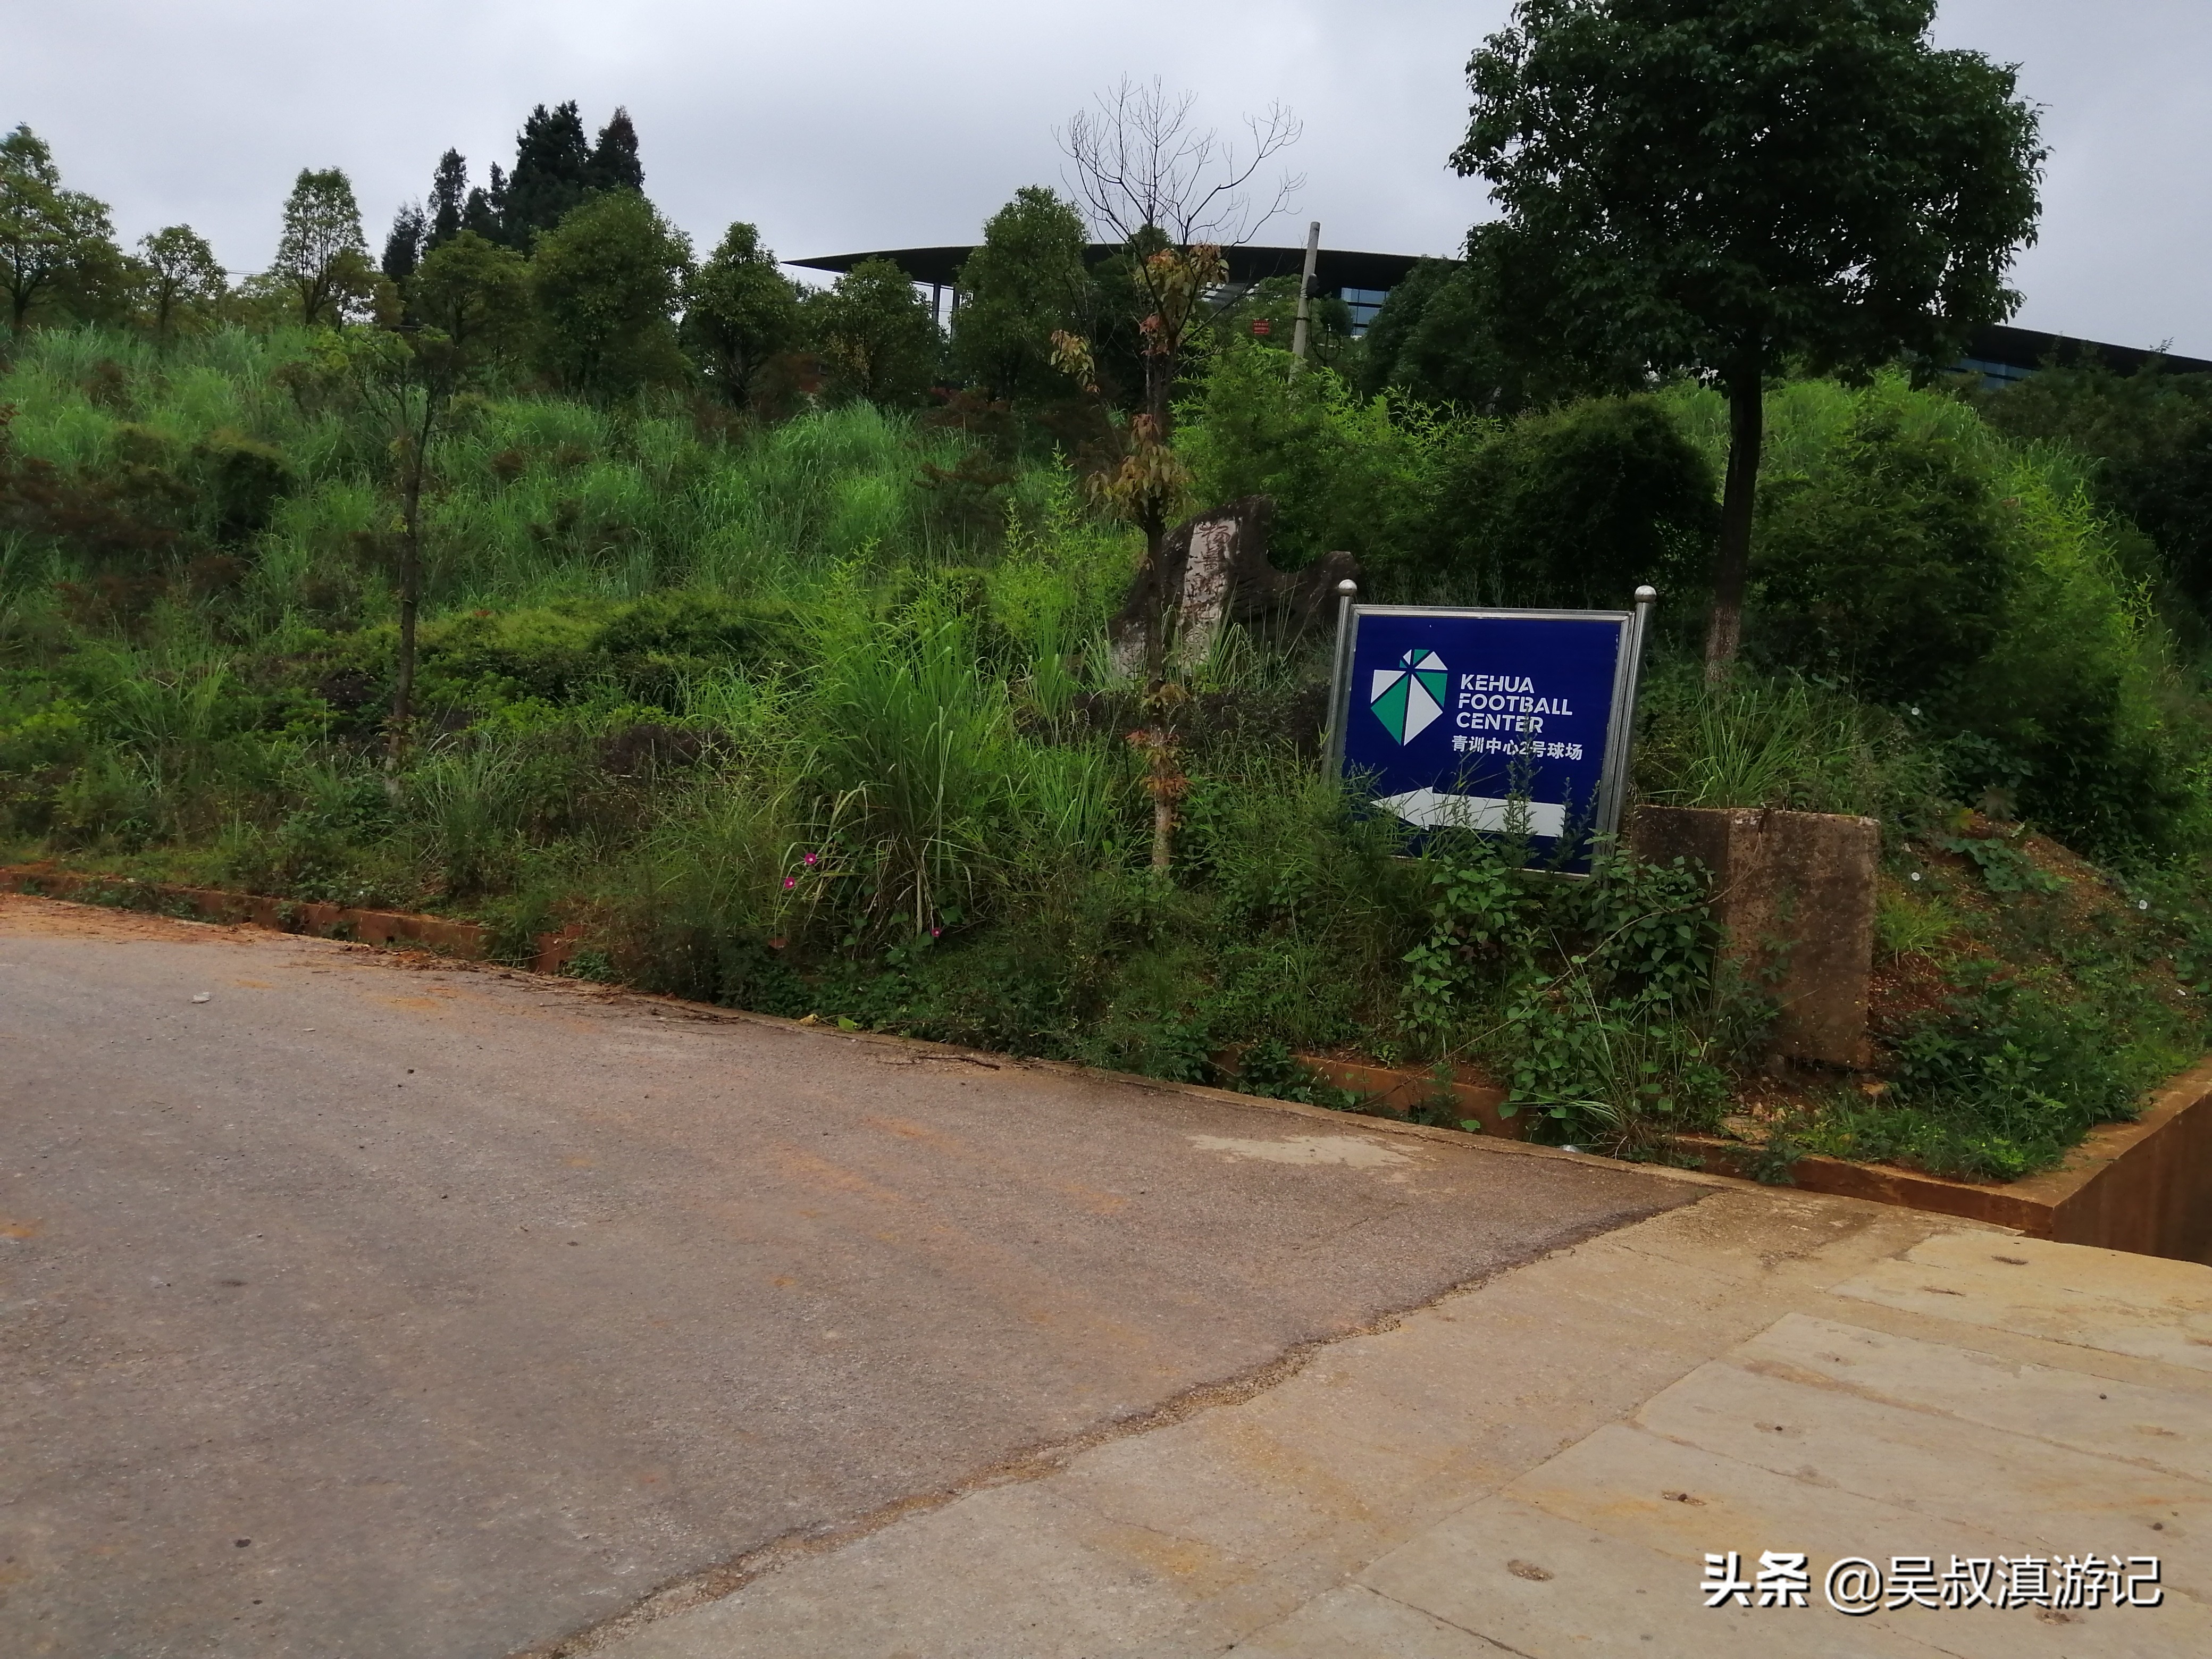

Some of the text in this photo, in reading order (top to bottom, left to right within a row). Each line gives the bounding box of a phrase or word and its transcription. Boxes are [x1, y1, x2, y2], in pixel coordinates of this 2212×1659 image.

[1461, 674, 1535, 693] KEHUA
[1458, 693, 1573, 716] FOOTBALL
[1456, 711, 1544, 733] CENTER
[1452, 735, 1583, 760] 青训中心2号球场
